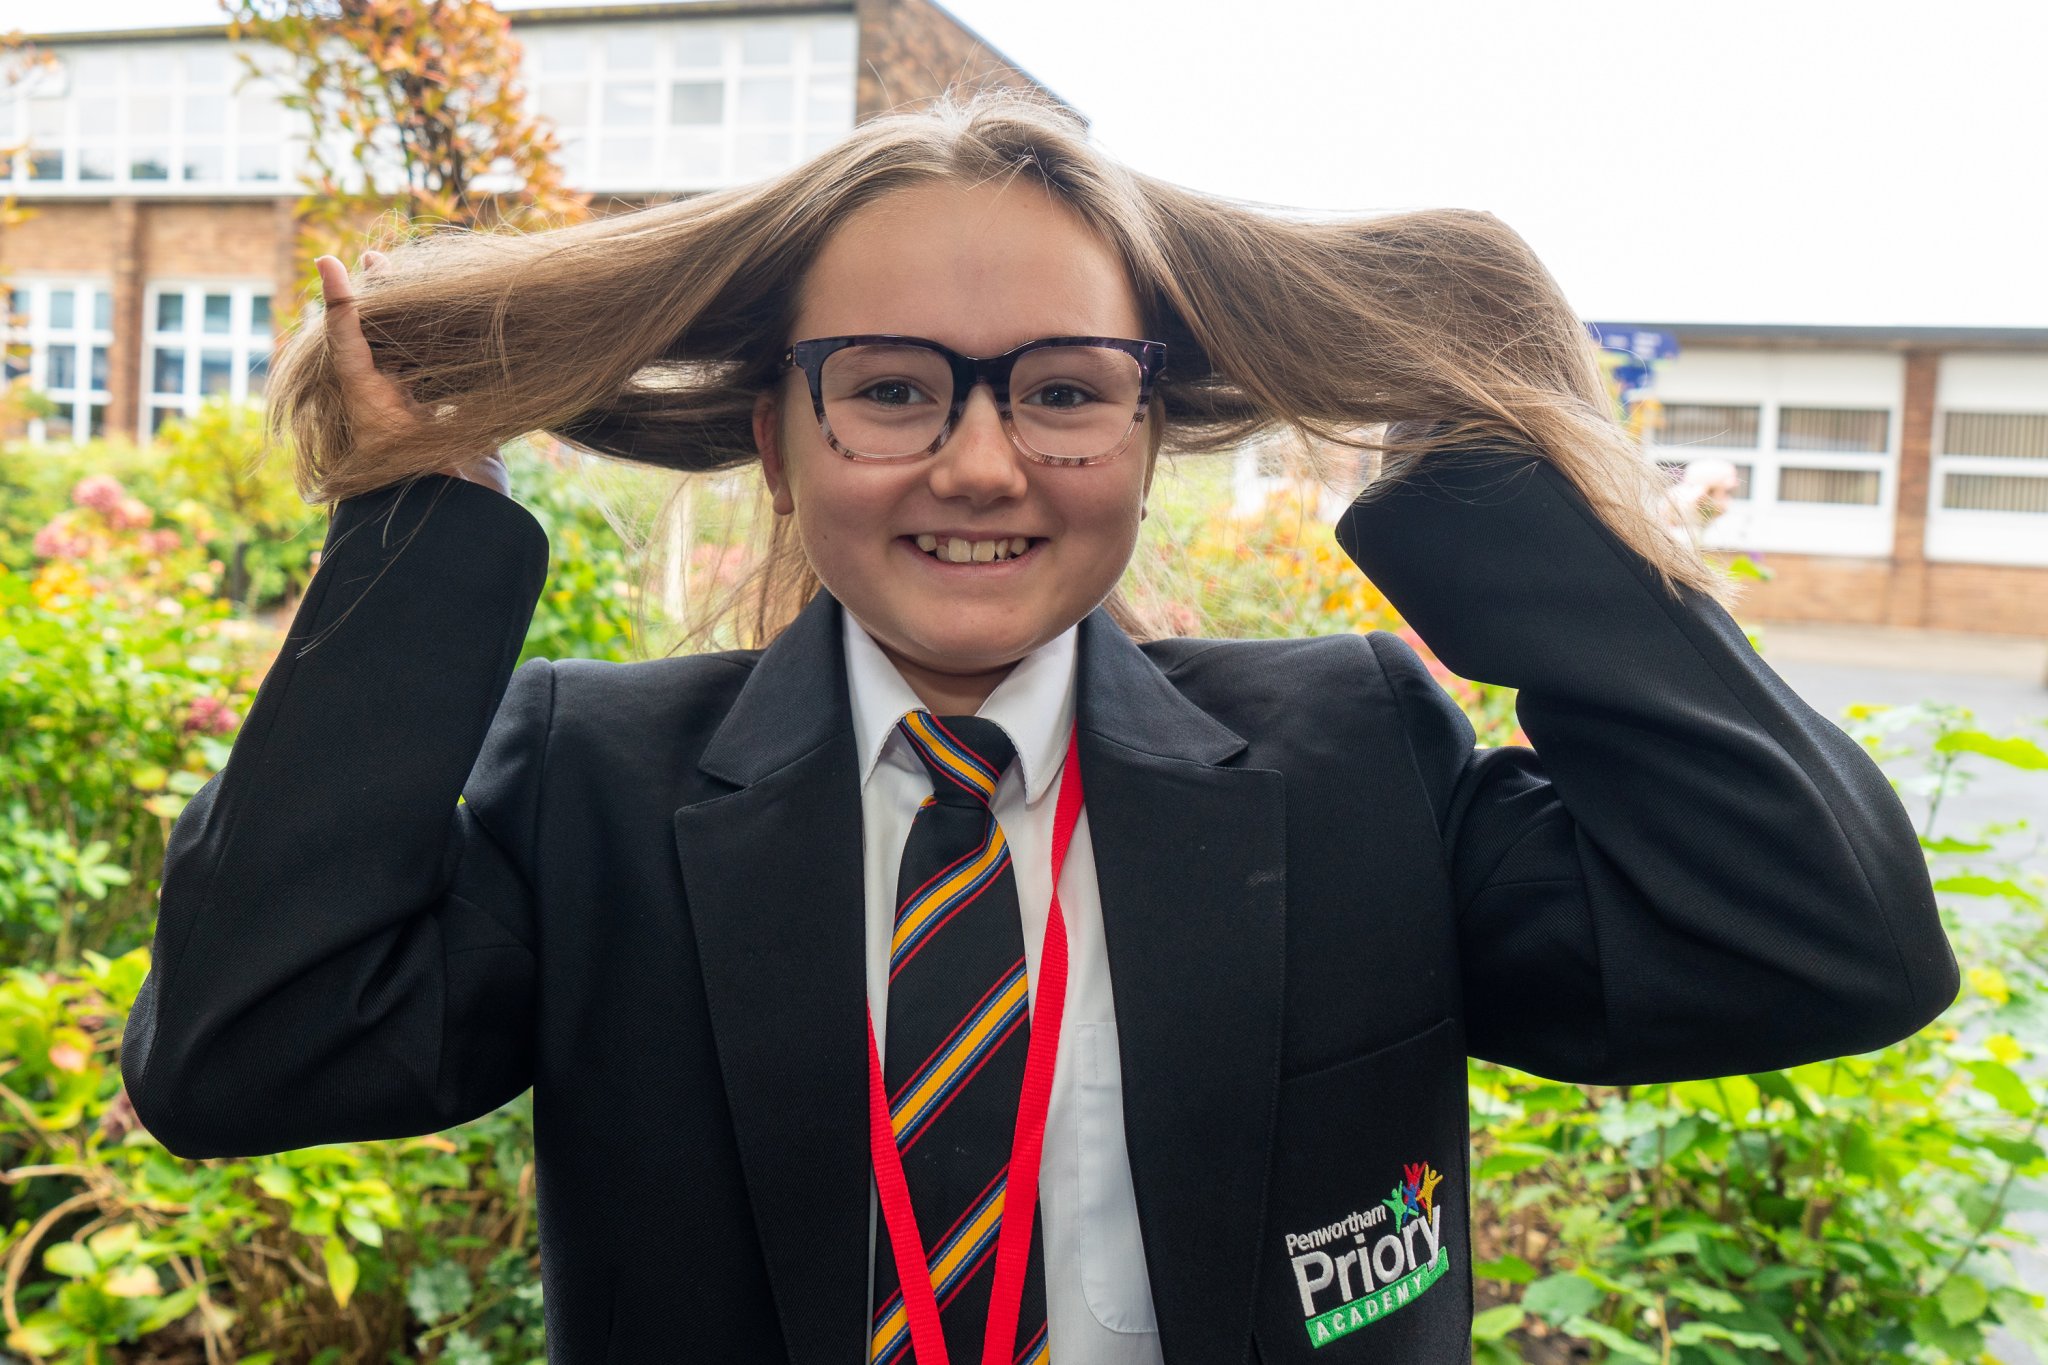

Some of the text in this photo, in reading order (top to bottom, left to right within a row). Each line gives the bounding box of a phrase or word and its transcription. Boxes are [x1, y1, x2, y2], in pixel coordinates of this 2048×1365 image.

[1285, 1204, 1387, 1256] Penwortham
[1290, 1204, 1441, 1317] Priory
[1315, 1273, 1424, 1342] ACADEMY
